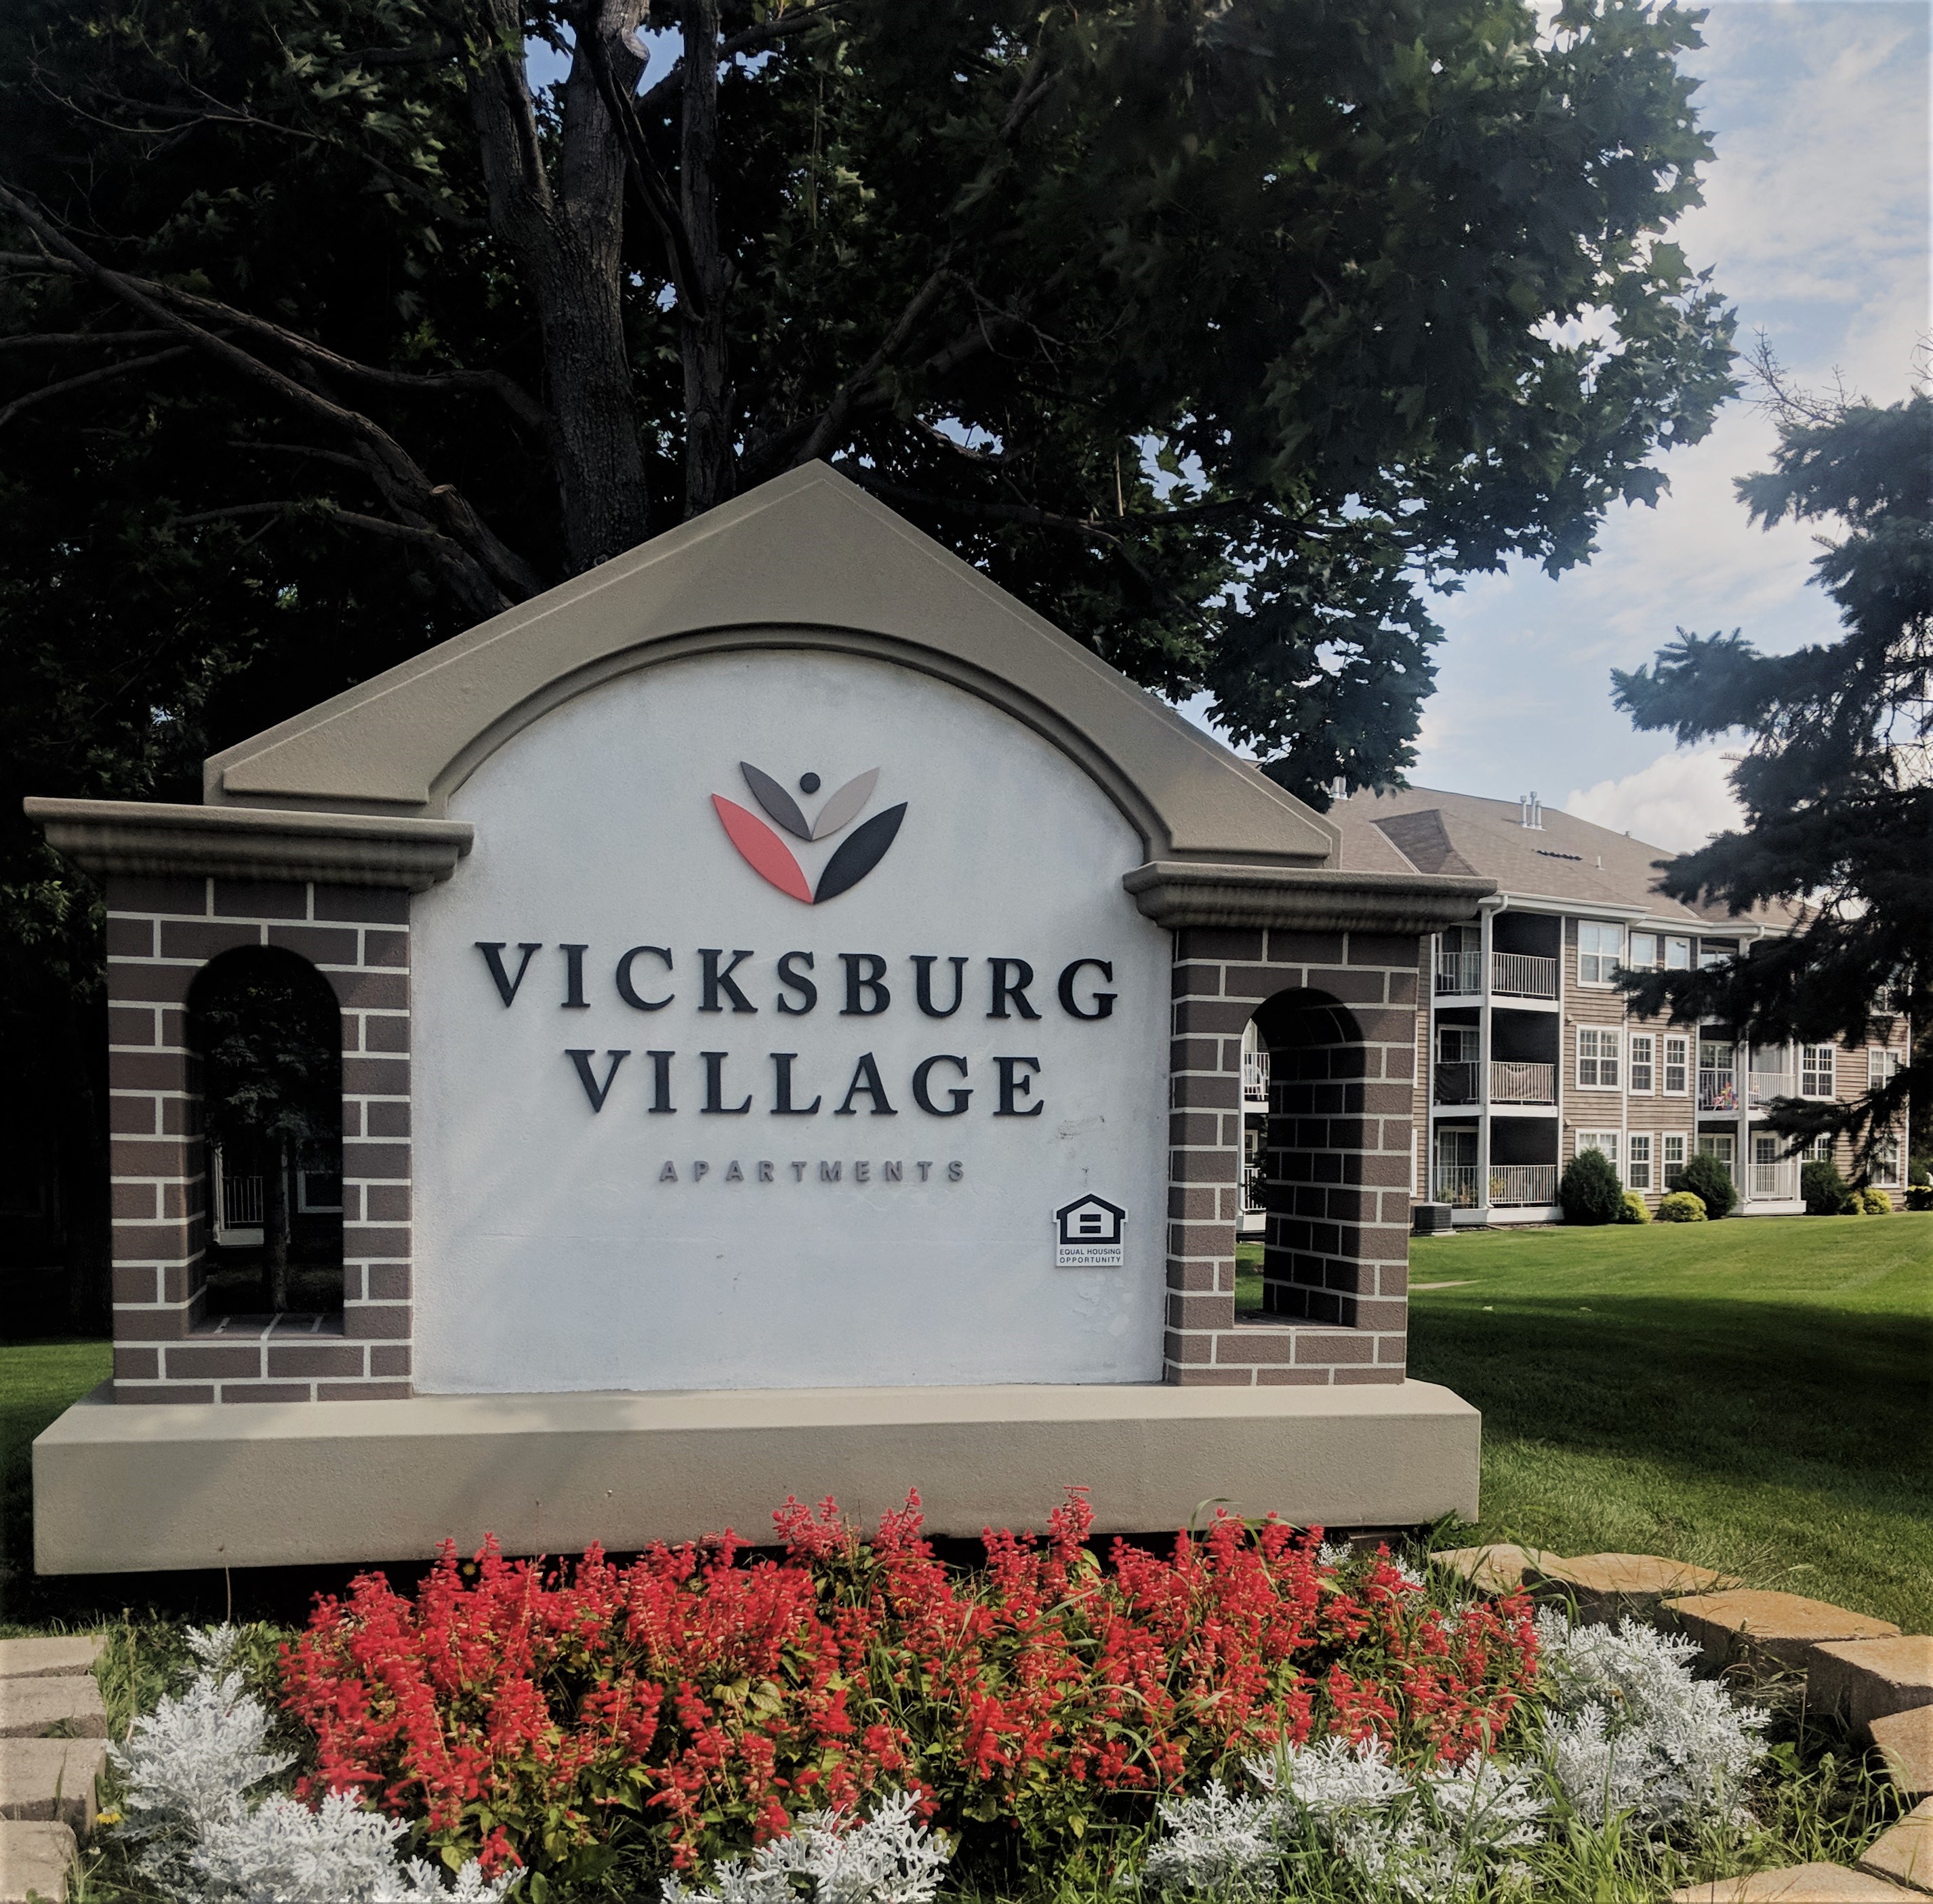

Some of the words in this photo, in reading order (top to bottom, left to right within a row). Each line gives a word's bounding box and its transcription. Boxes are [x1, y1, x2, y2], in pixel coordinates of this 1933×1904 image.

[474, 941, 1118, 1021] VICKSBURG
[564, 1049, 1044, 1118] VILLAGE
[659, 1160, 965, 1183] APARTMENTS
